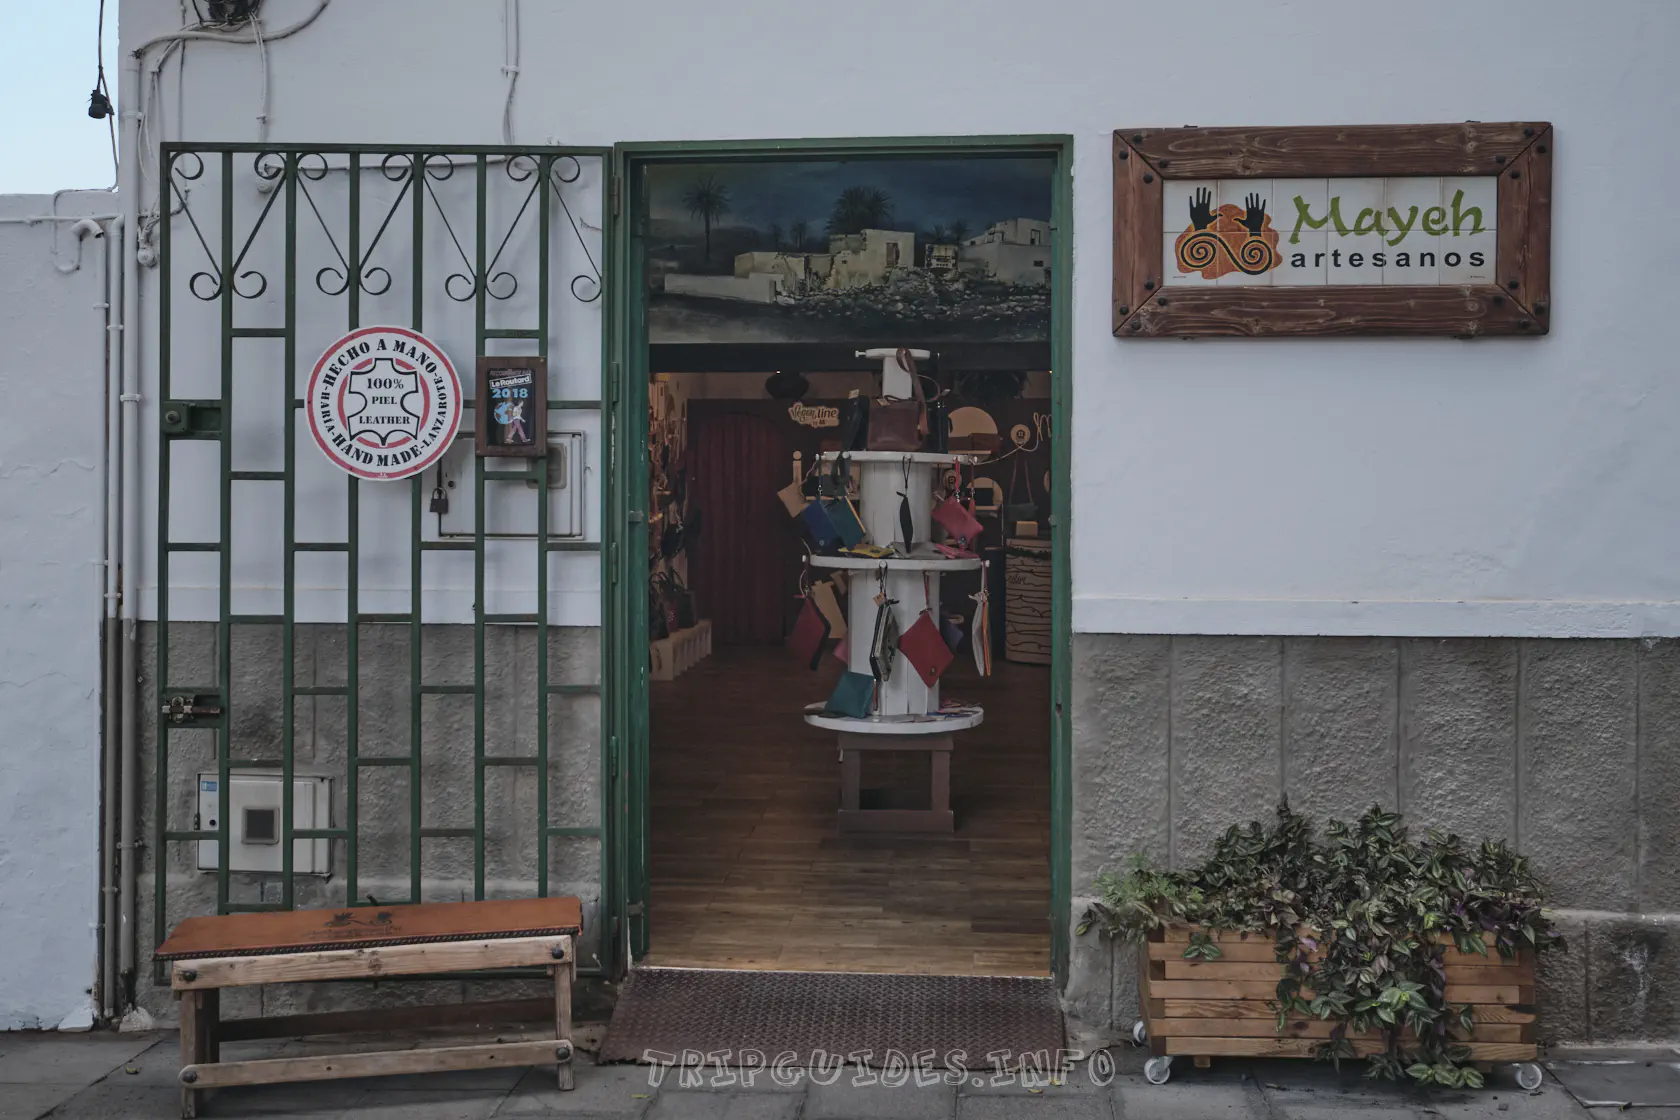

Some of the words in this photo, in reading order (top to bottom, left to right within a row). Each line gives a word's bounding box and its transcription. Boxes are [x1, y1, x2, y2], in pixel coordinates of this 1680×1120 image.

[1288, 188, 1487, 247] Mayeh
[1290, 250, 1485, 268] artesanos
[322, 341, 370, 388] HECHO
[376, 338, 388, 351] A
[367, 377, 404, 390] 100%
[499, 375, 530, 387] Routard
[491, 388, 529, 399] 2018
[371, 396, 398, 405] PIEL
[817, 407, 837, 418] line
[359, 416, 411, 425] LEATHER
